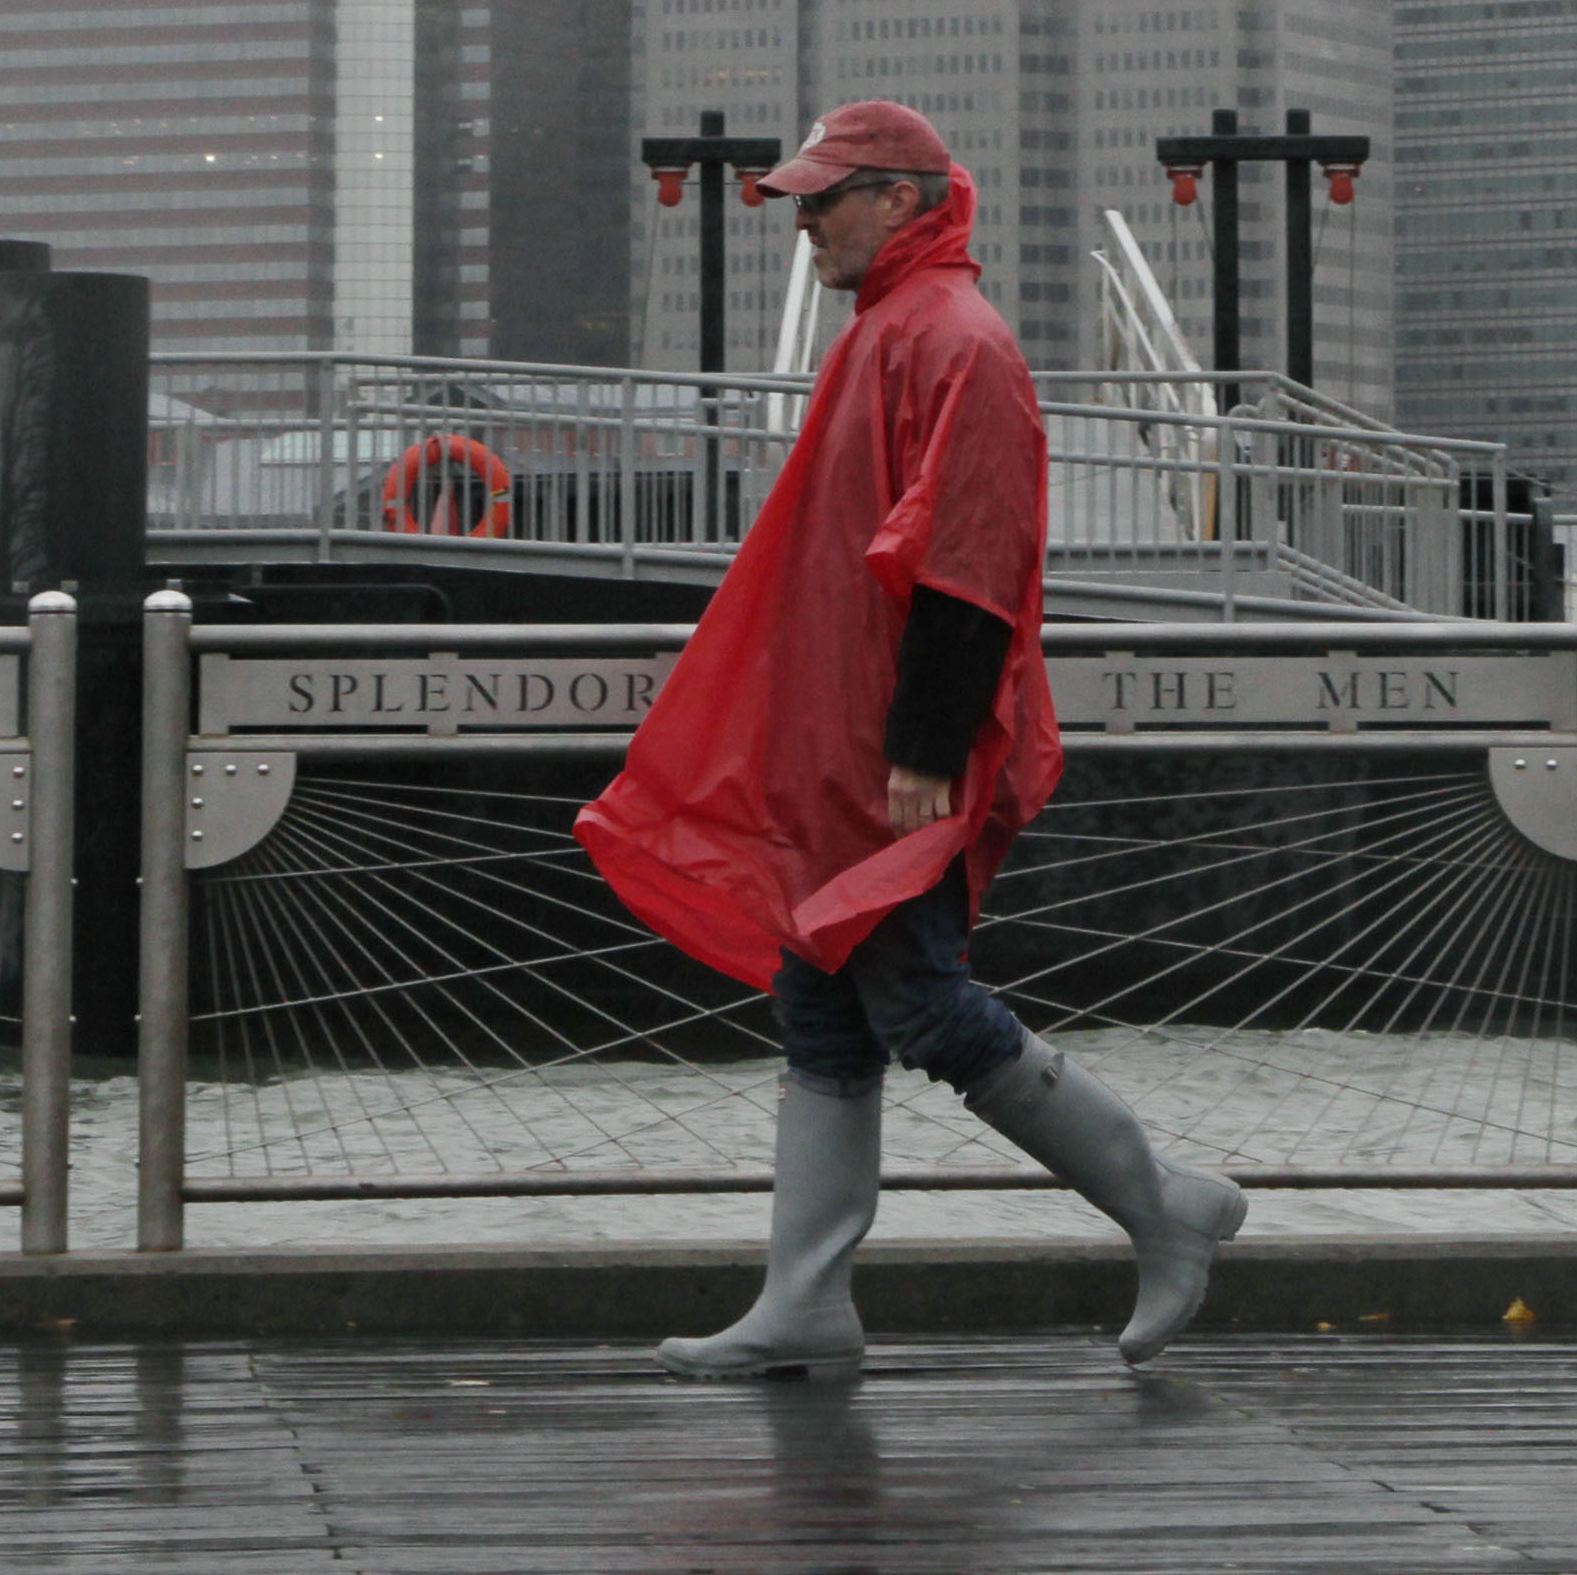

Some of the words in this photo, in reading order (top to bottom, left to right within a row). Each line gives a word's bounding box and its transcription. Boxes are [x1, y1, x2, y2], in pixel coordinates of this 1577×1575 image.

[287, 672, 657, 714] SPLENDOR
[1101, 671, 1239, 711] THE
[1316, 671, 1461, 711] MEN
